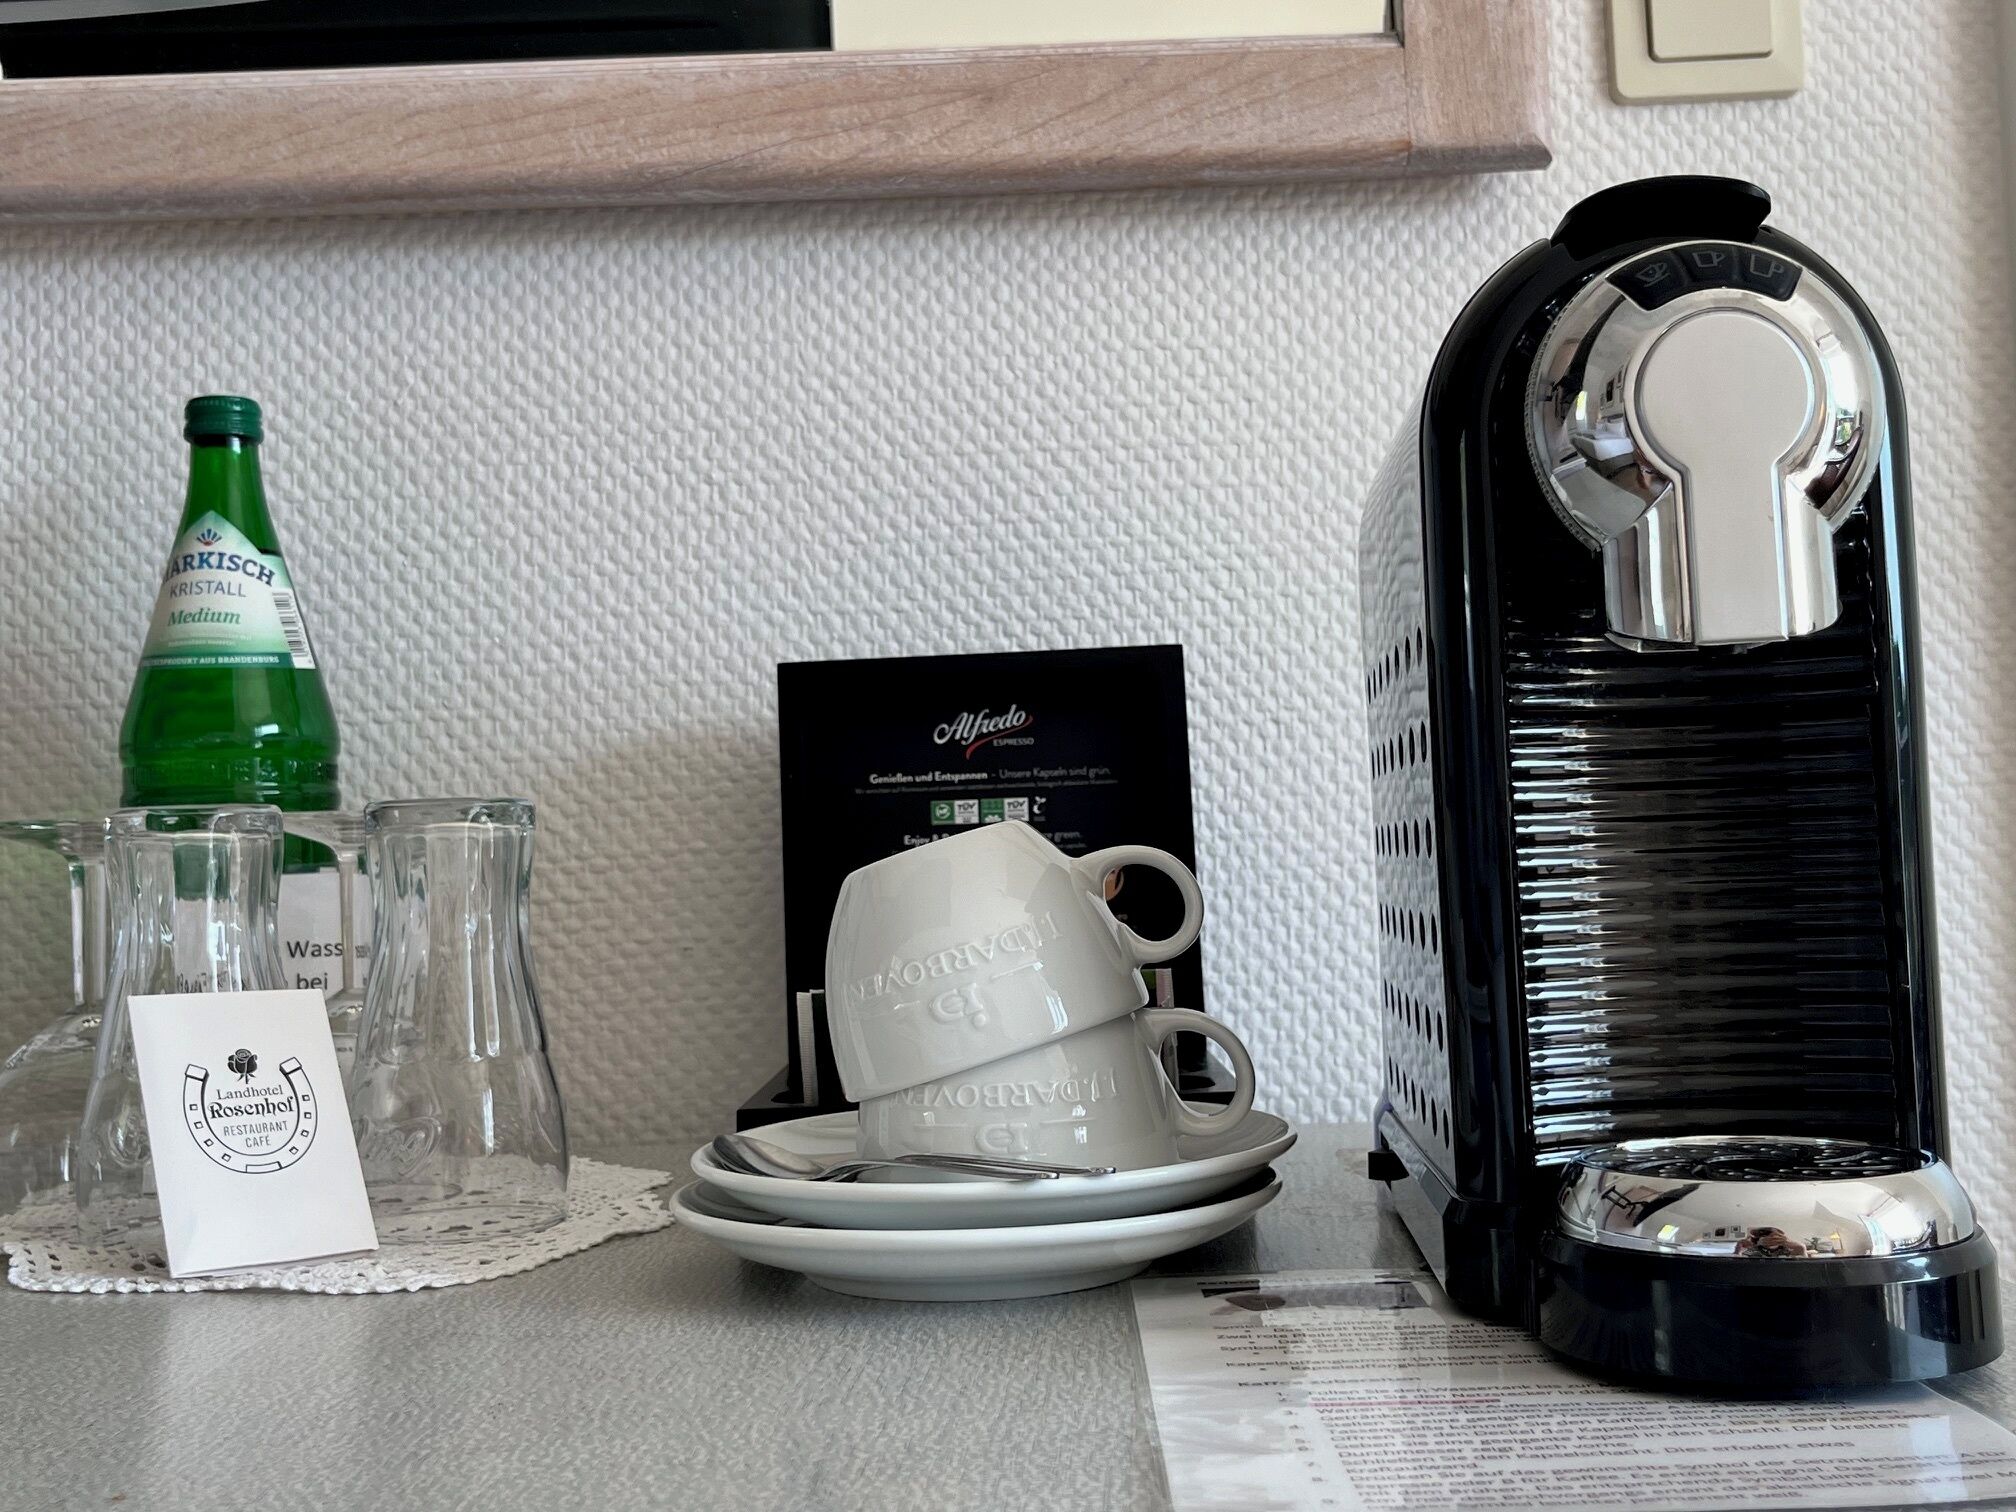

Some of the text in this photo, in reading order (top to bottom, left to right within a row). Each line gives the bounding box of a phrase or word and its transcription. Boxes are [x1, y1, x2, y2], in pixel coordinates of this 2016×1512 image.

[168, 580, 247, 598] KRISTALL
[167, 607, 241, 627] Medium
[217, 655, 279, 665] BRANDENBURG
[933, 704, 1027, 745] Alfredo
[992, 737, 1035, 747] ESPRESSO
[869, 772, 914, 784] Genießen
[914, 771, 933, 782] und
[934, 771, 988, 784] Entspannen
[998, 768, 1032, 779] Unsere
[1033, 766, 1068, 780] Kapseln
[1068, 766, 1087, 776] sind
[957, 802, 977, 811] TÜV
[1007, 800, 1026, 809] TÜV
[286, 940, 344, 958] Wass
[296, 972, 328, 990] bei
[216, 1084, 284, 1100] Landhotel
[208, 1096, 294, 1119] Rosenhof
[223, 1120, 288, 1136] RESTAURANT
[1432, 1384, 1530, 1392] Wassertank
[1321, 1411, 1459, 1421] Getränketasten
[1467, 1414, 1554, 1423] geeignete
[1330, 1425, 1444, 1434] Tassengröße
[1481, 1436, 1572, 1446] geeignete
[1578, 1432, 1639, 1441] Kapsel
[1339, 1449, 1464, 1457] Durchmesser
[1472, 1446, 1514, 1454] zeigt
[1342, 1458, 1435, 1466] Schließen
[1713, 1444, 1791, 1452] erfodert
[1355, 1482, 1442, 1490] Espresso
[1659, 1470, 1722, 1478] ertönt
[1879, 1461, 1935, 1470] Gerät
[1552, 1465, 1671, 1476] gewünschte
[1675, 1462, 1749, 1471] Symbol
[1503, 1491, 1647, 1500] Brühvorgangs
[1766, 1481, 1874, 1491] akustische
[1878, 1477, 1941, 1486] Signal
[1580, 1478, 1734, 1490] entsprechende
[1738, 1475, 1814, 1485] Symbol
[1631, 1494, 1747, 1505] permanent
